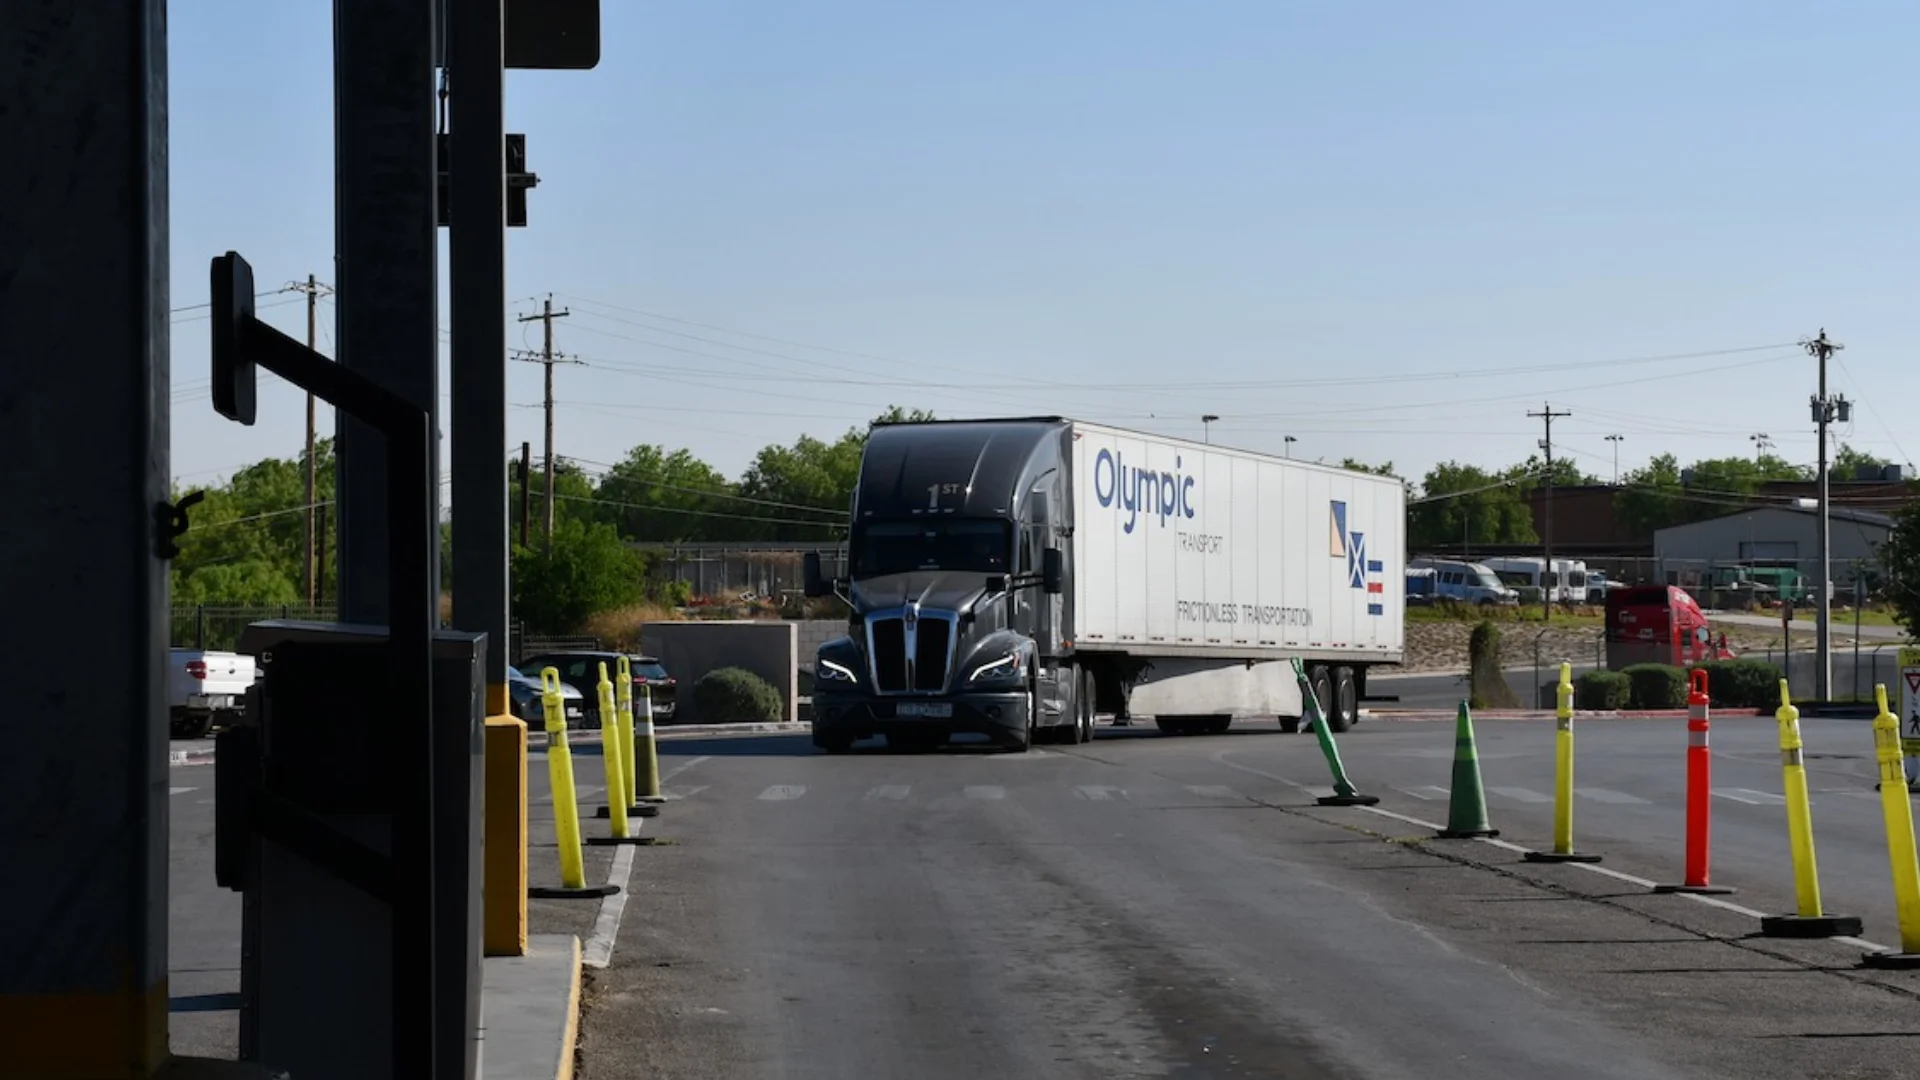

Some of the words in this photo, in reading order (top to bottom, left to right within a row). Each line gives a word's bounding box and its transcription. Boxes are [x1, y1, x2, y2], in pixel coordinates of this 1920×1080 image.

[1095, 447, 1195, 535] Olympic
[1178, 531, 1223, 555] TRANSPORT
[1177, 600, 1238, 624] FRICTIONLESS
[1242, 603, 1313, 627] TRANSPORTATION
